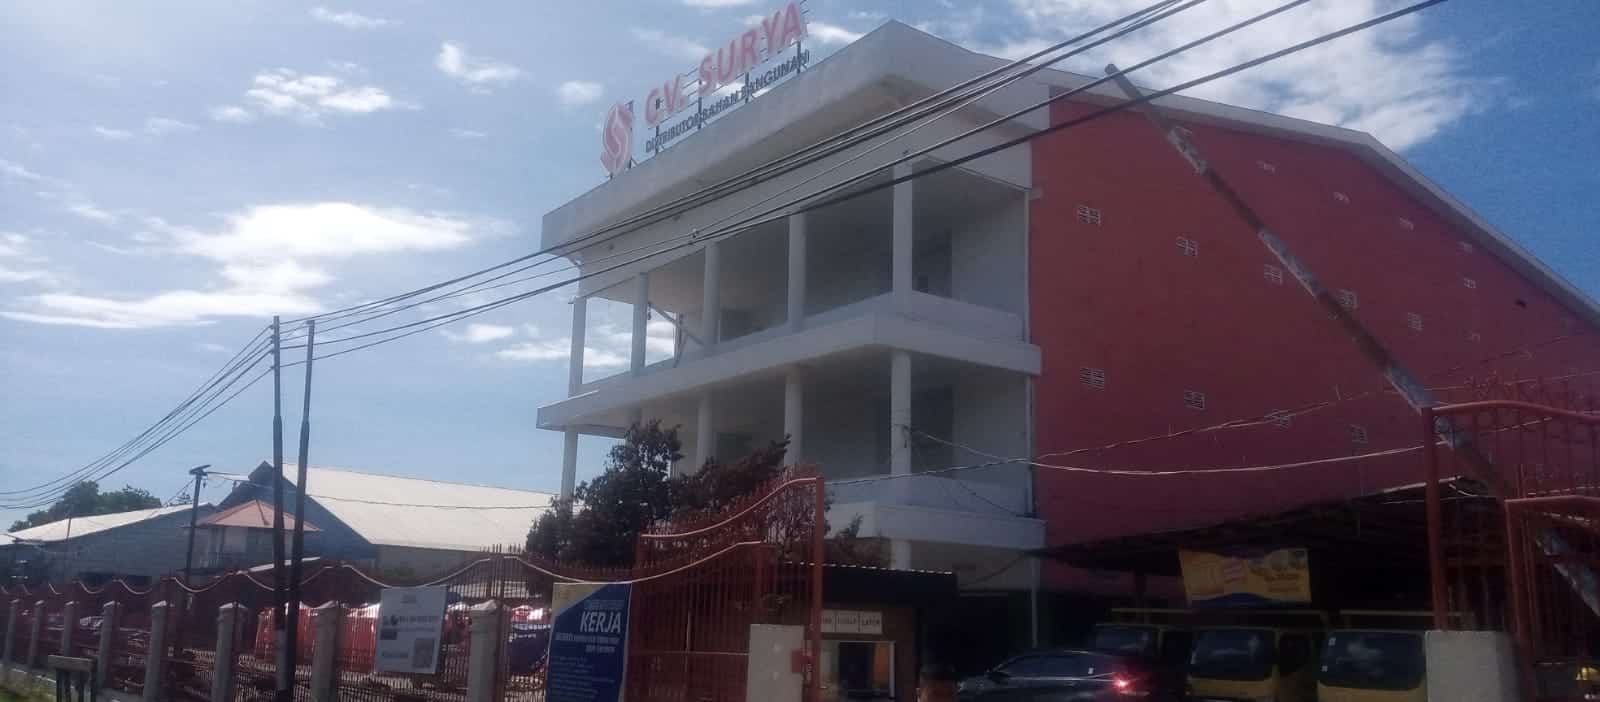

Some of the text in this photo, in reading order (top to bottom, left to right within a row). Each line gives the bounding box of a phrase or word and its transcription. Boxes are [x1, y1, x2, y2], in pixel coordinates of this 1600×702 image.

[645, 1, 802, 126] CV. SURYA
[701, 89, 739, 122] BAHAN
[741, 50, 810, 101] BANGUNAN
[579, 611, 622, 633] KERJA
